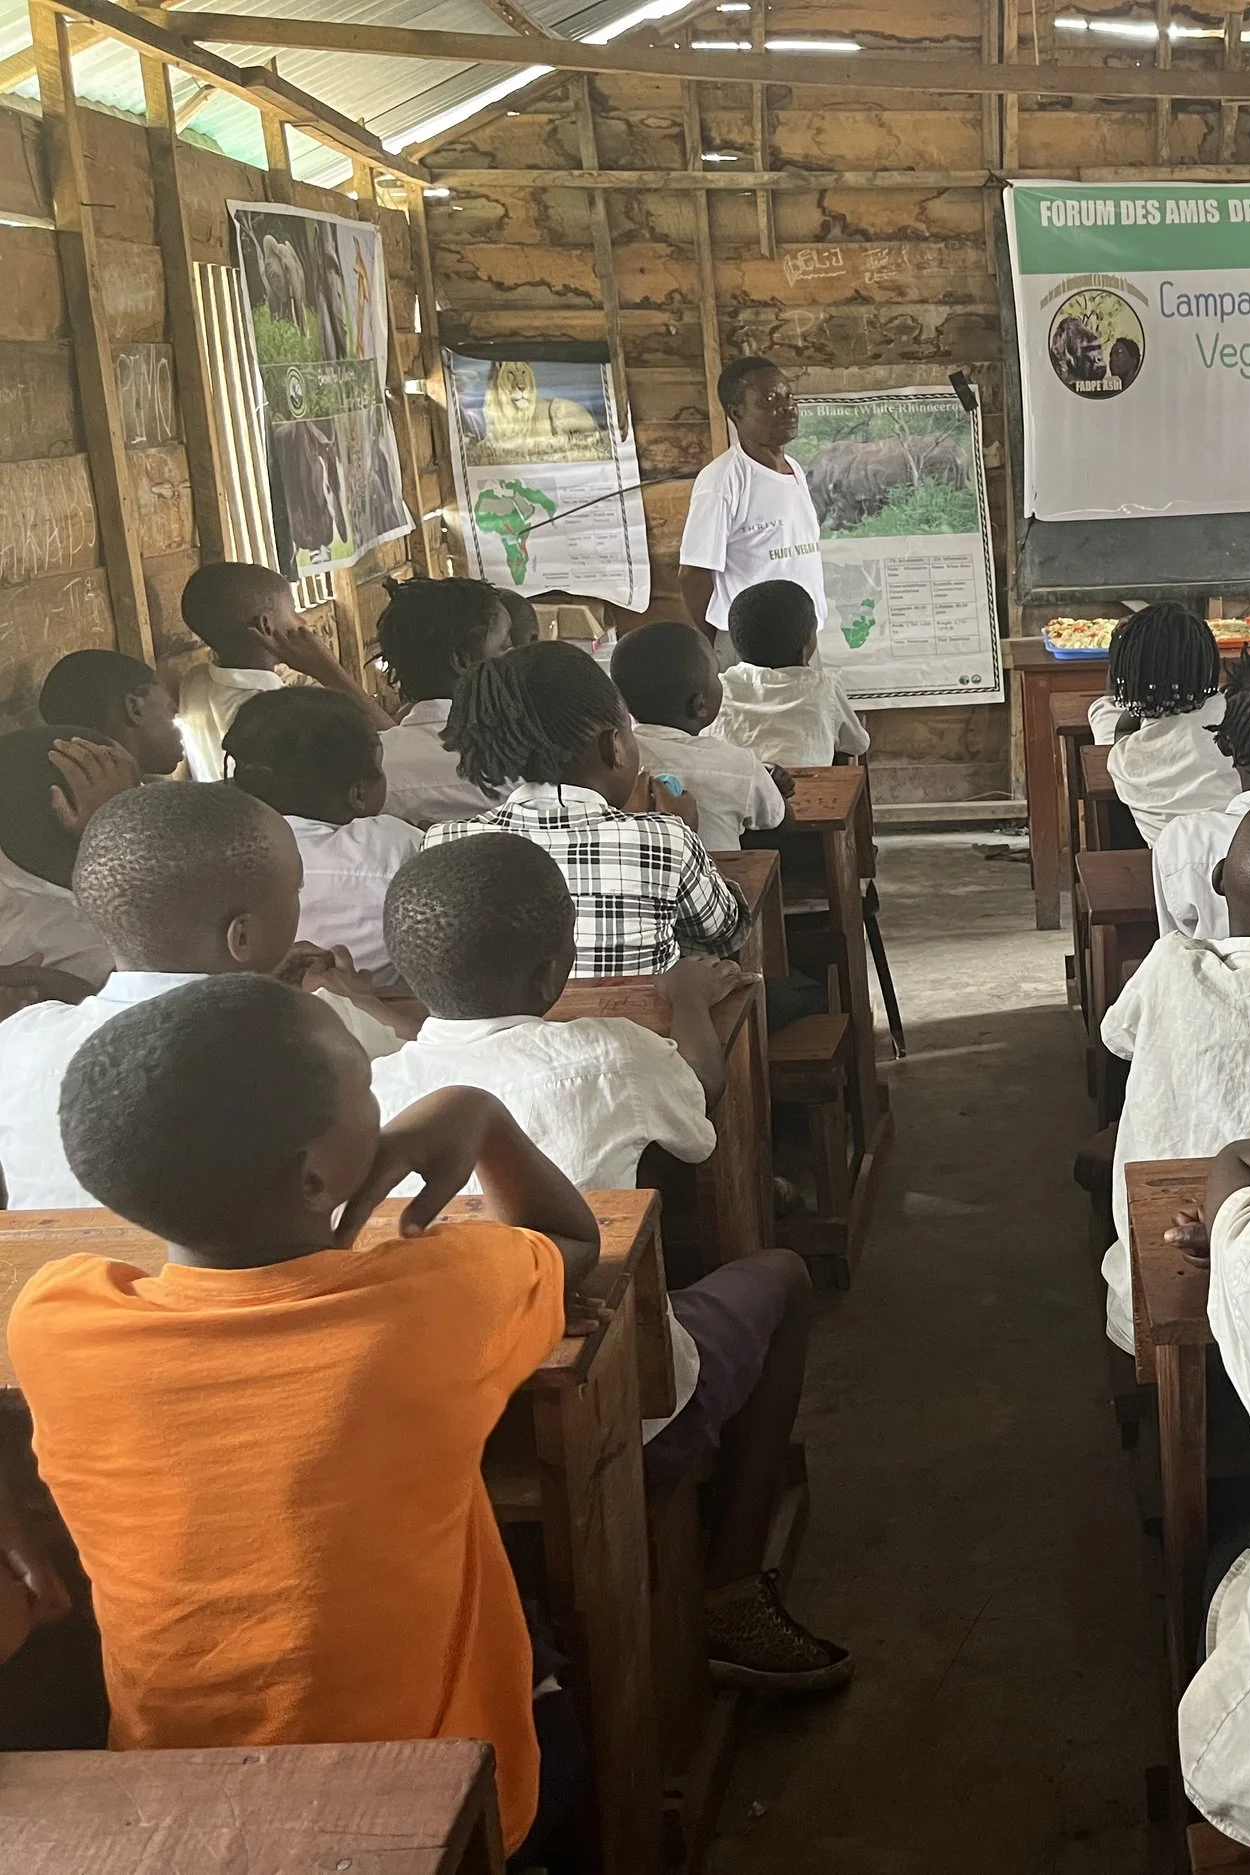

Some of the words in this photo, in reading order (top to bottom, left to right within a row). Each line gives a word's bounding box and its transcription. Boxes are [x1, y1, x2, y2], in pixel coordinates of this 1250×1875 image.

[1040, 199, 1115, 227] FORUM
[1120, 199, 1161, 226] DES
[1165, 199, 1220, 224] AMIS
[1076, 380, 1102, 392] FADPE
[741, 519, 785, 533] THRIVE
